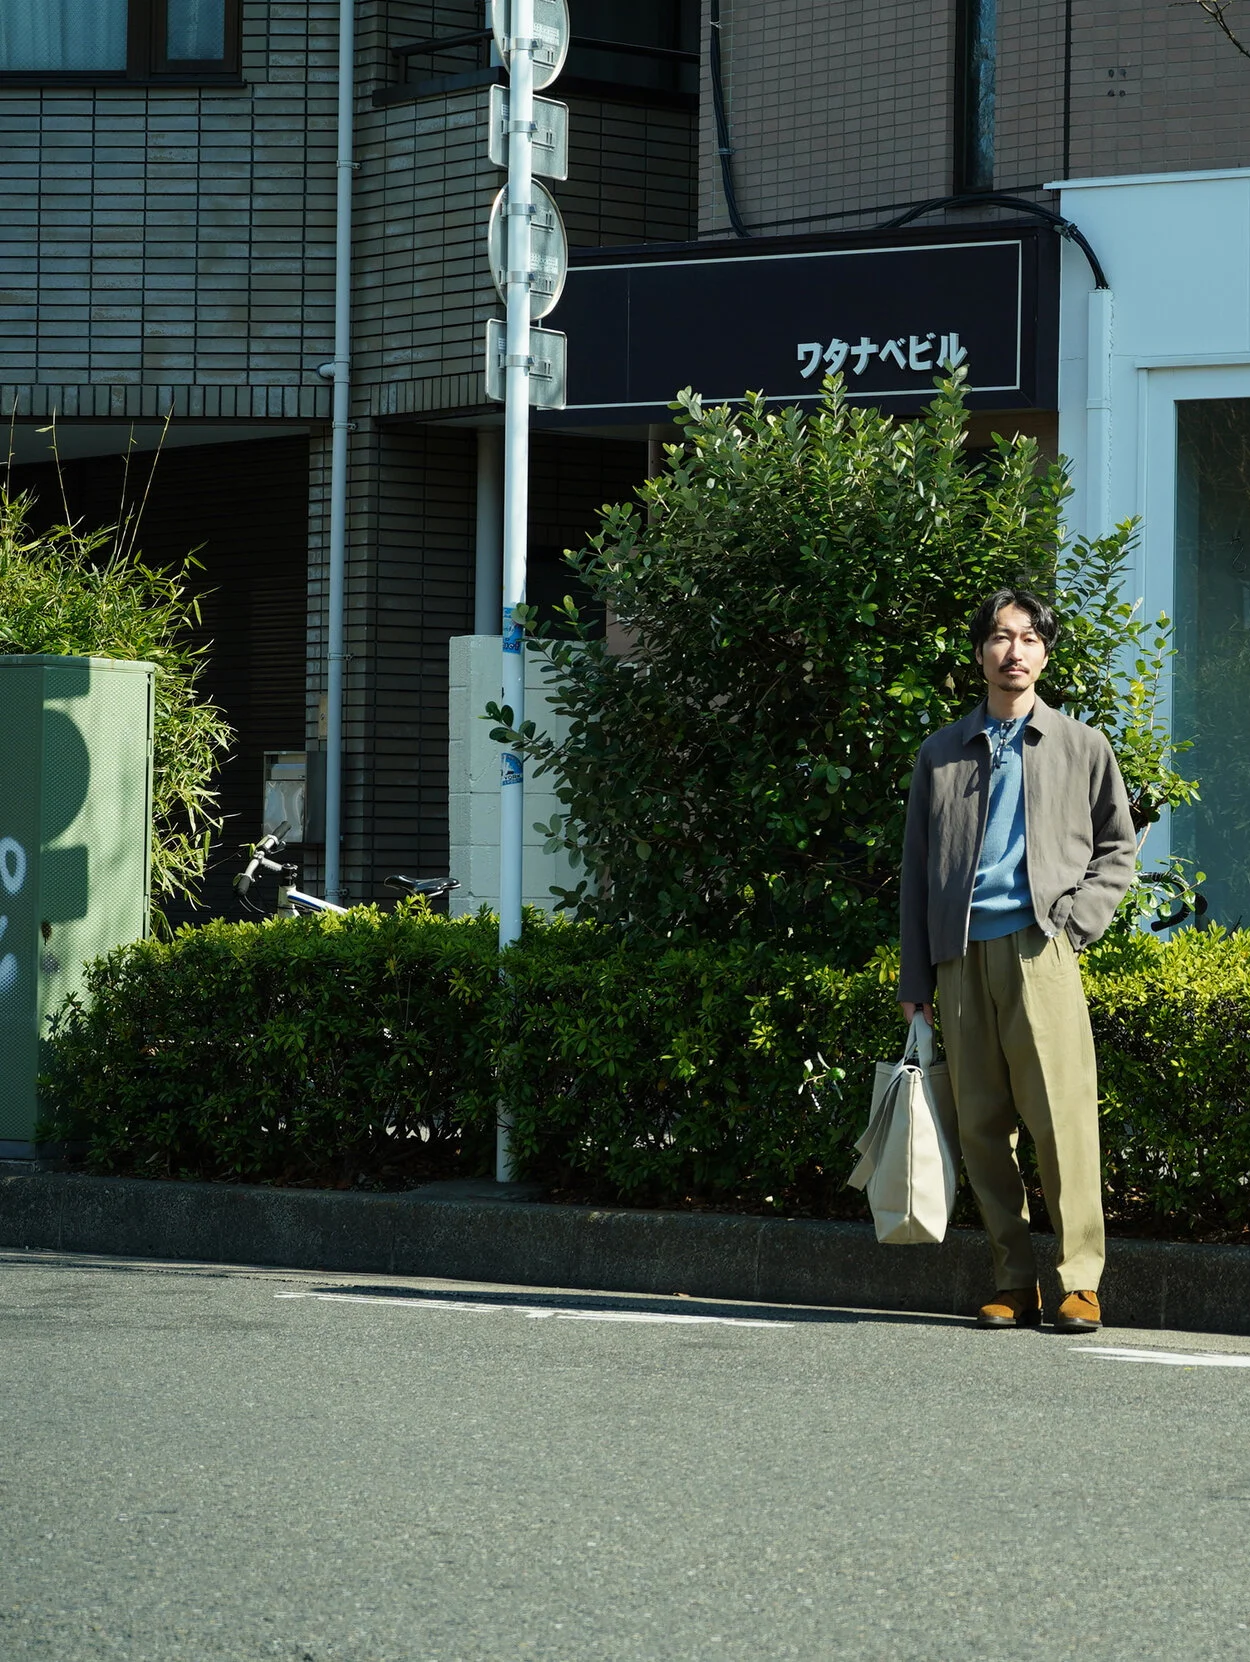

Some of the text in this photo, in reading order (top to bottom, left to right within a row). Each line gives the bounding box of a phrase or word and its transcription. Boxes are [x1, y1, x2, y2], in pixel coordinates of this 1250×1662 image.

[797, 332, 968, 379] ワタナベビル
